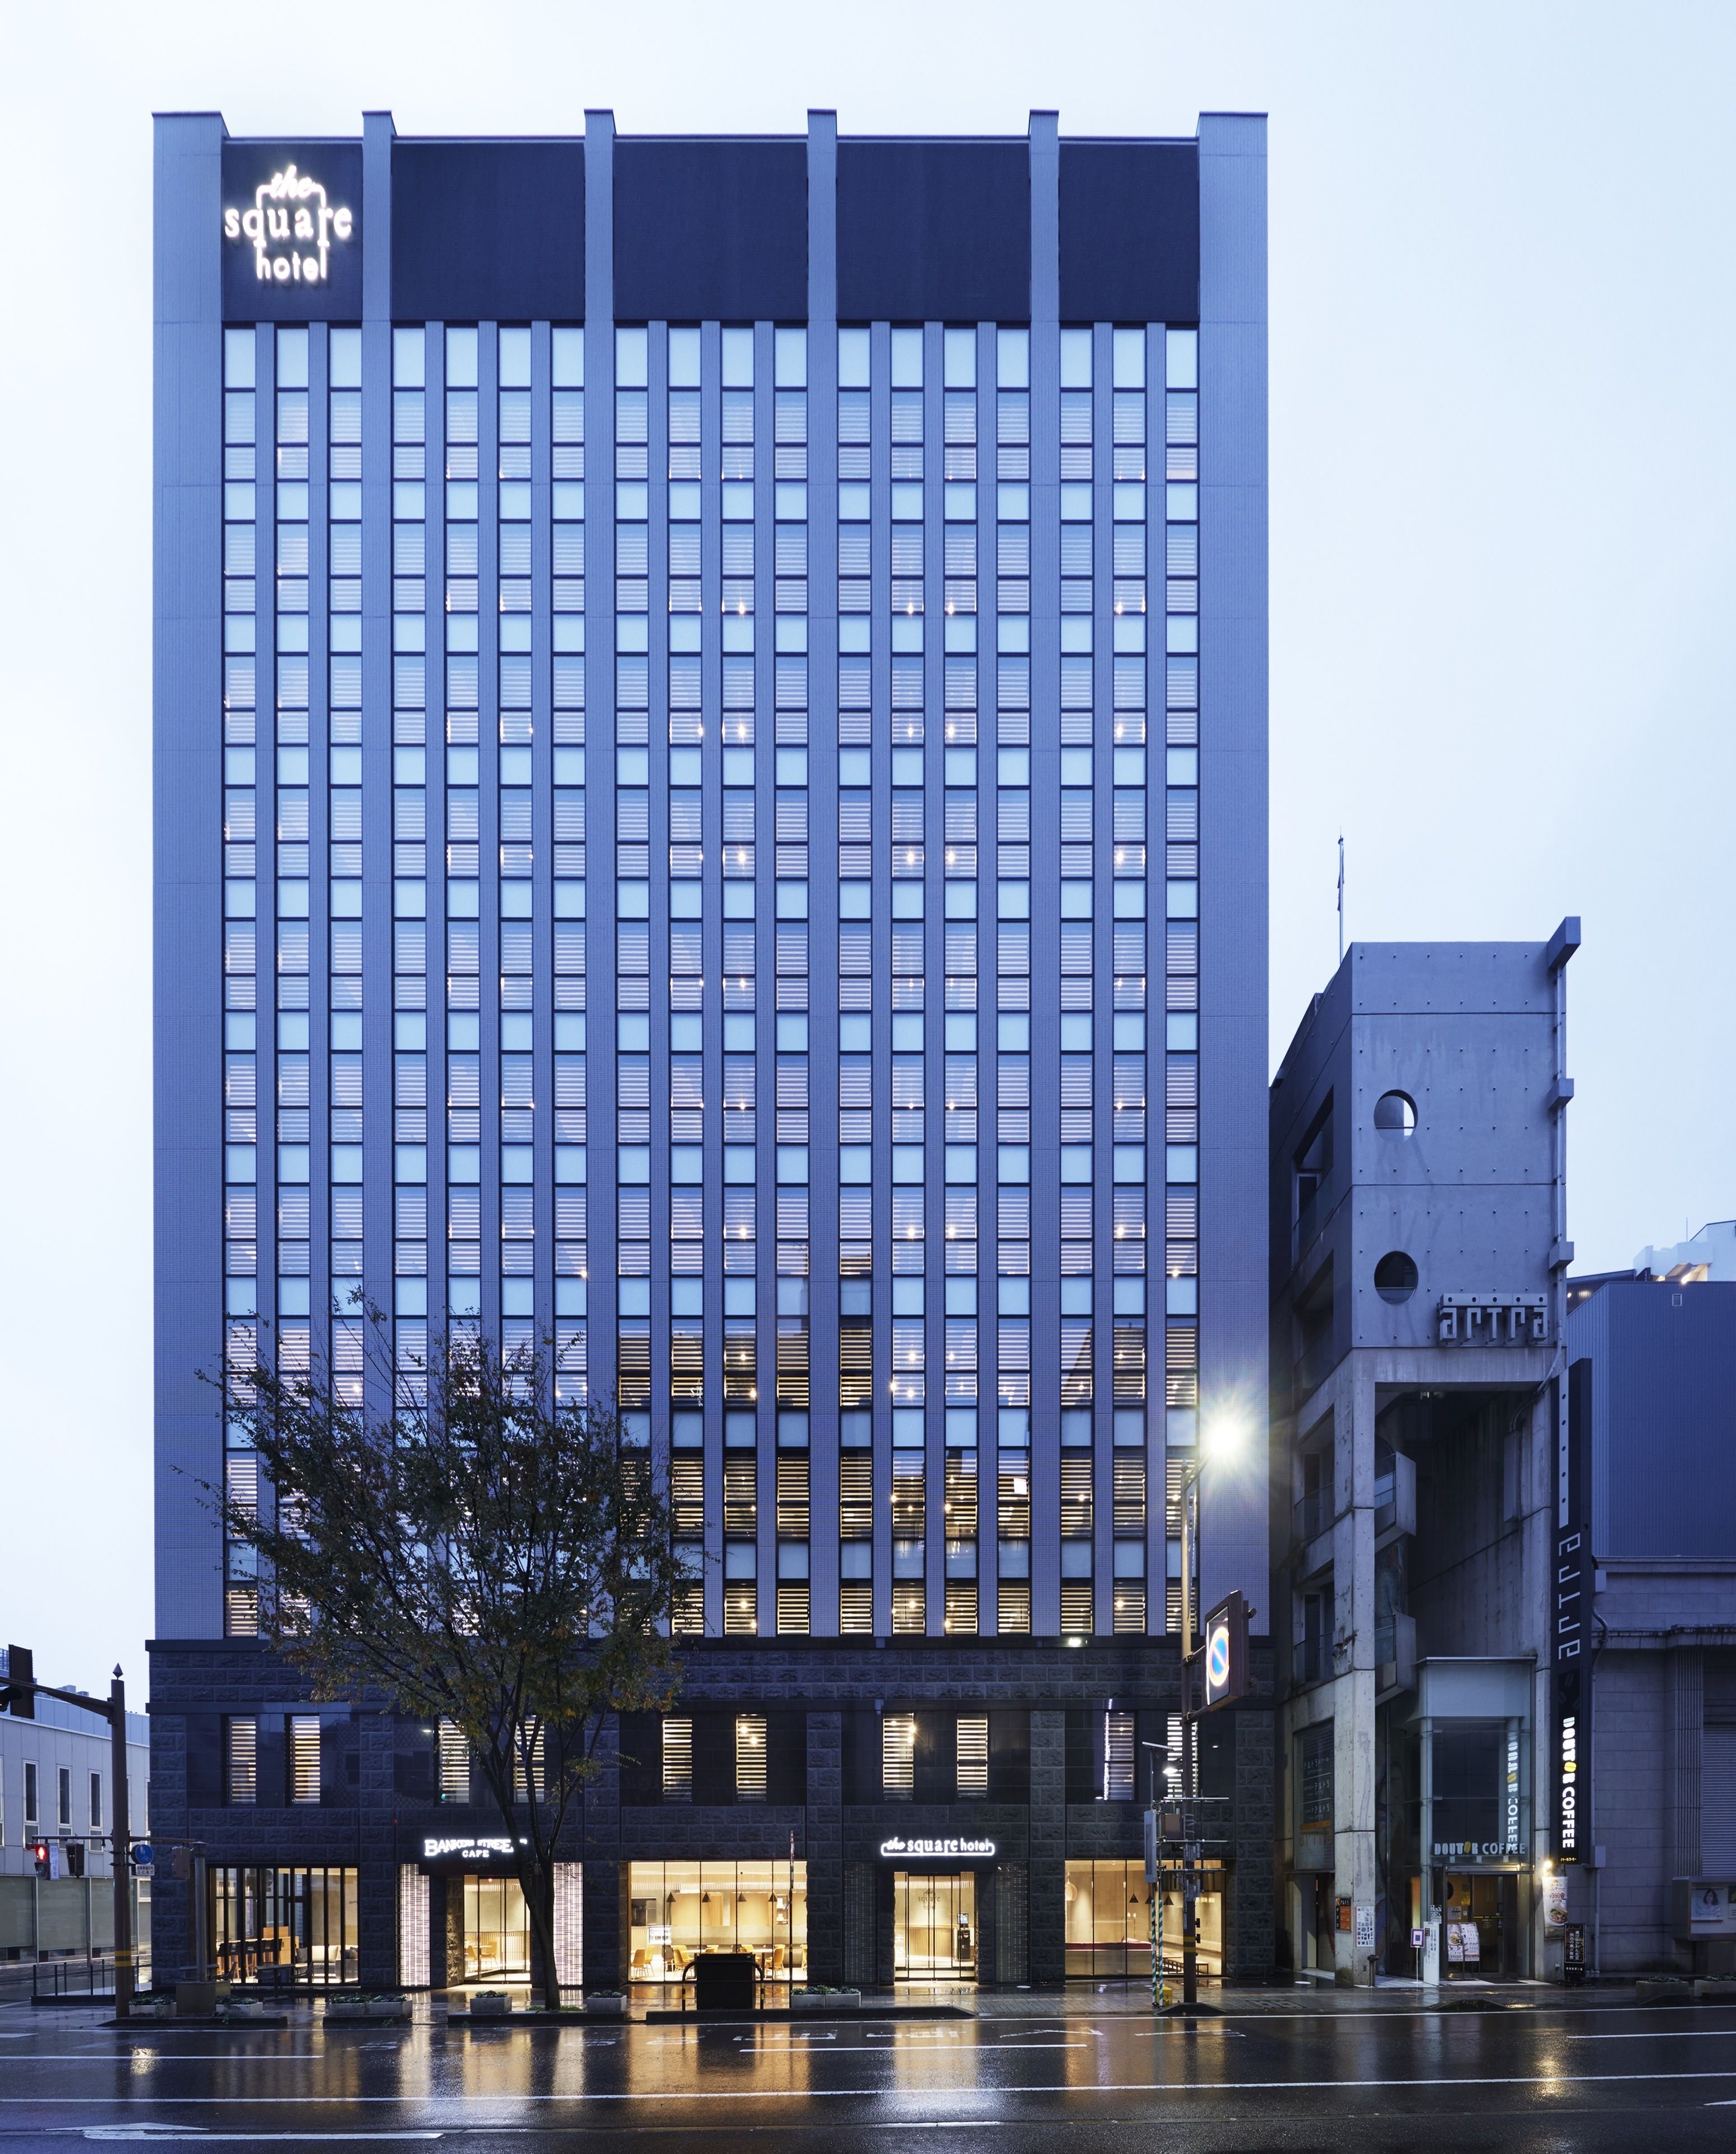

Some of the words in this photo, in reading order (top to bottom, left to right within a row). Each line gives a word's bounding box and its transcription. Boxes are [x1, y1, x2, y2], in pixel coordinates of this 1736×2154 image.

[270, 164, 312, 198] the
[224, 208, 352, 247] square
[256, 247, 328, 280] hotel
[1562, 1716, 1577, 1784] DOUTOR
[1562, 1786, 1576, 1849] COFFEE
[462, 1849, 490, 1858] CAFE
[477, 1839, 528, 1853] STREE
[886, 1837, 906, 1851] the
[907, 1839, 959, 1854] square
[960, 1837, 989, 1852] hotel
[1434, 1841, 1479, 1855] DOUTOR
[1482, 1842, 1526, 1855] COFFEE
